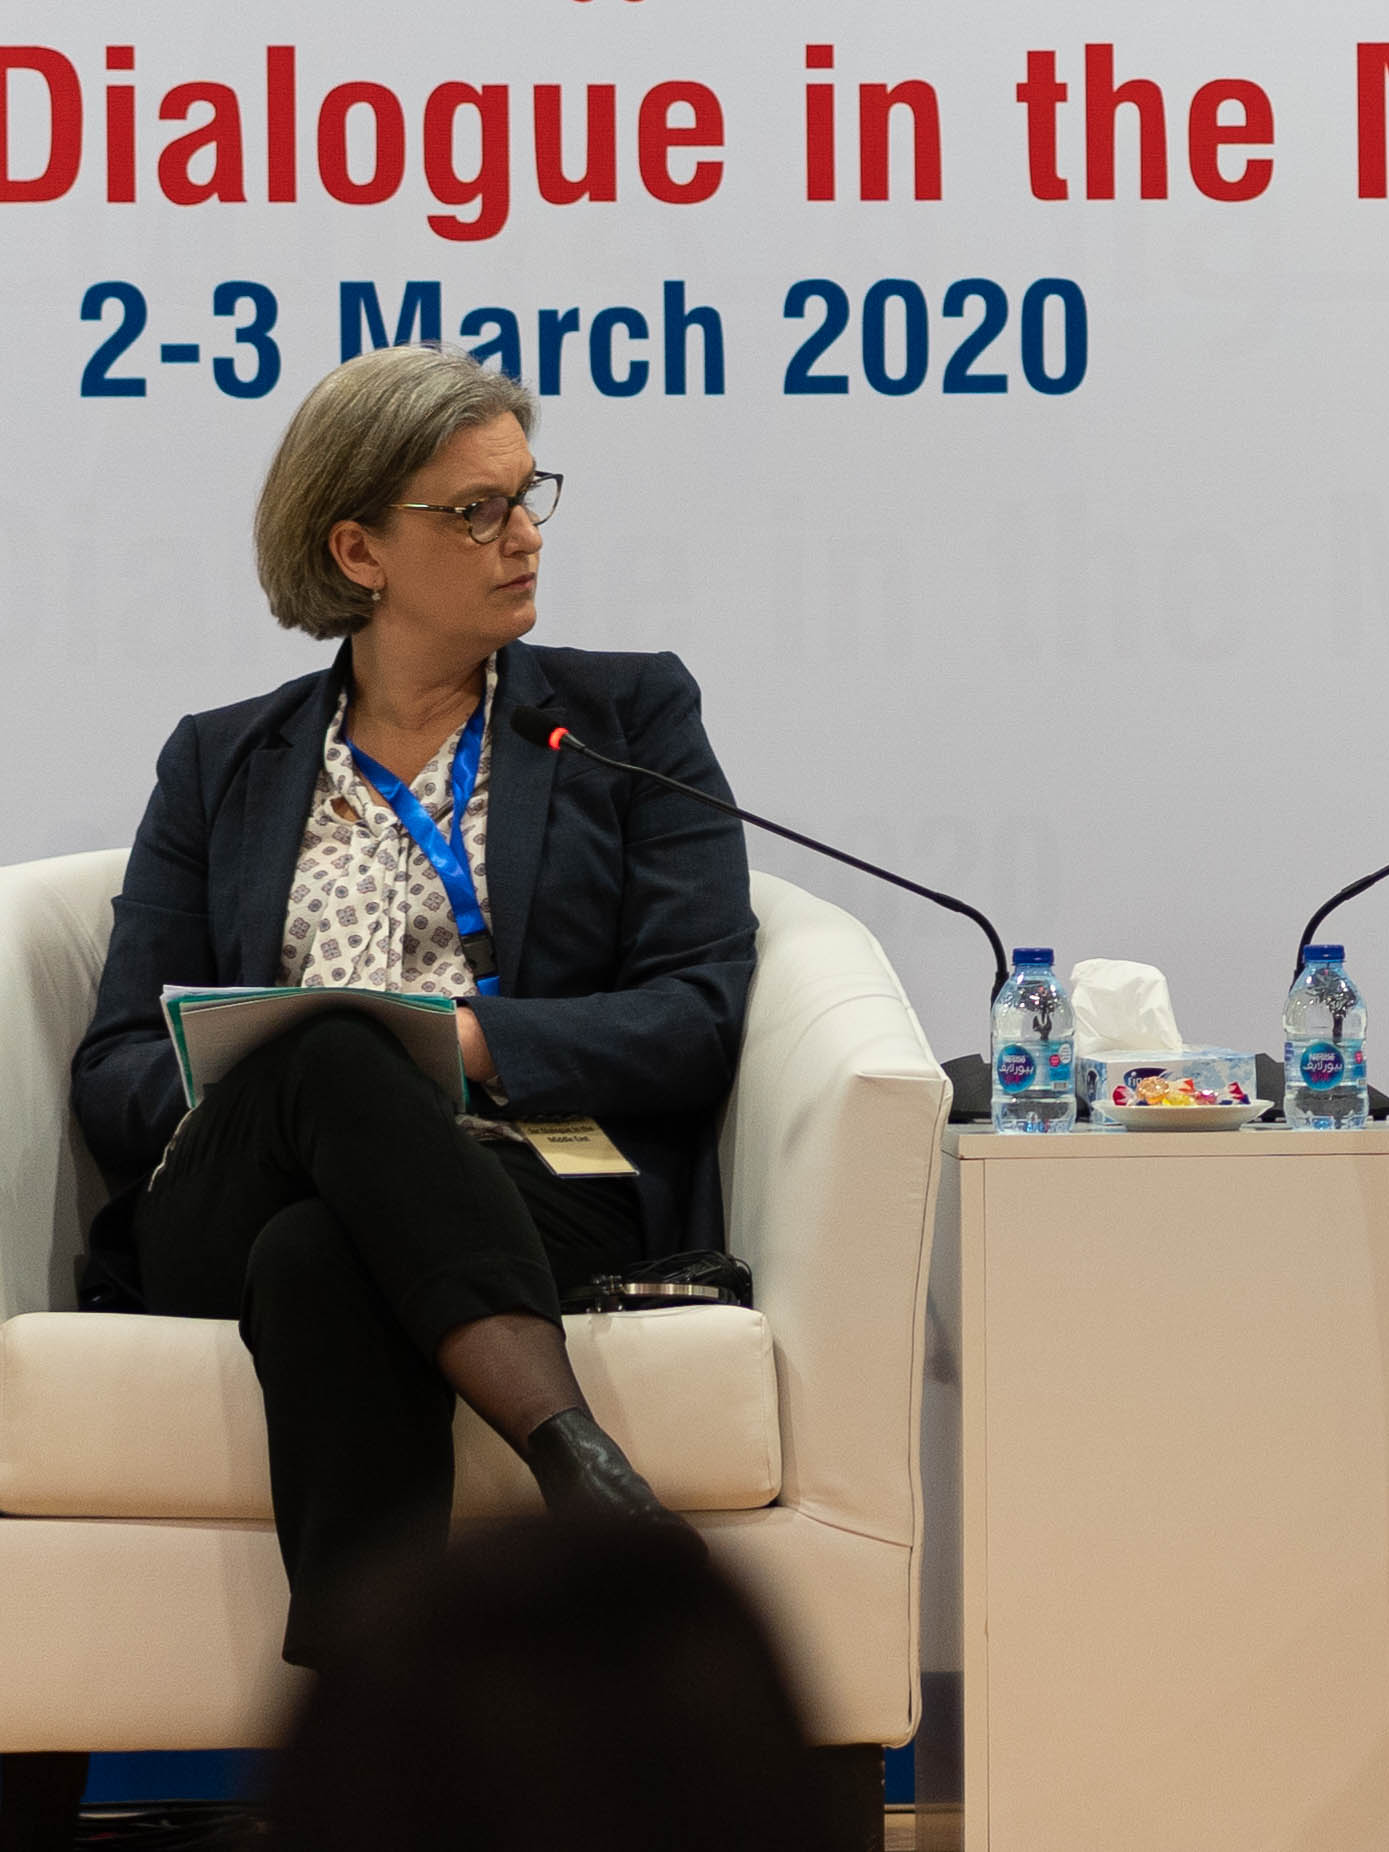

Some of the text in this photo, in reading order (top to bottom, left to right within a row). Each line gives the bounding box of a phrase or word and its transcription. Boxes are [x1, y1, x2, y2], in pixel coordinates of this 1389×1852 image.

[0, 45, 725, 242] Dialogue
[805, 44, 942, 202] in
[1015, 43, 1275, 203] the
[80, 277, 1088, 399] 2-3 March 2020
